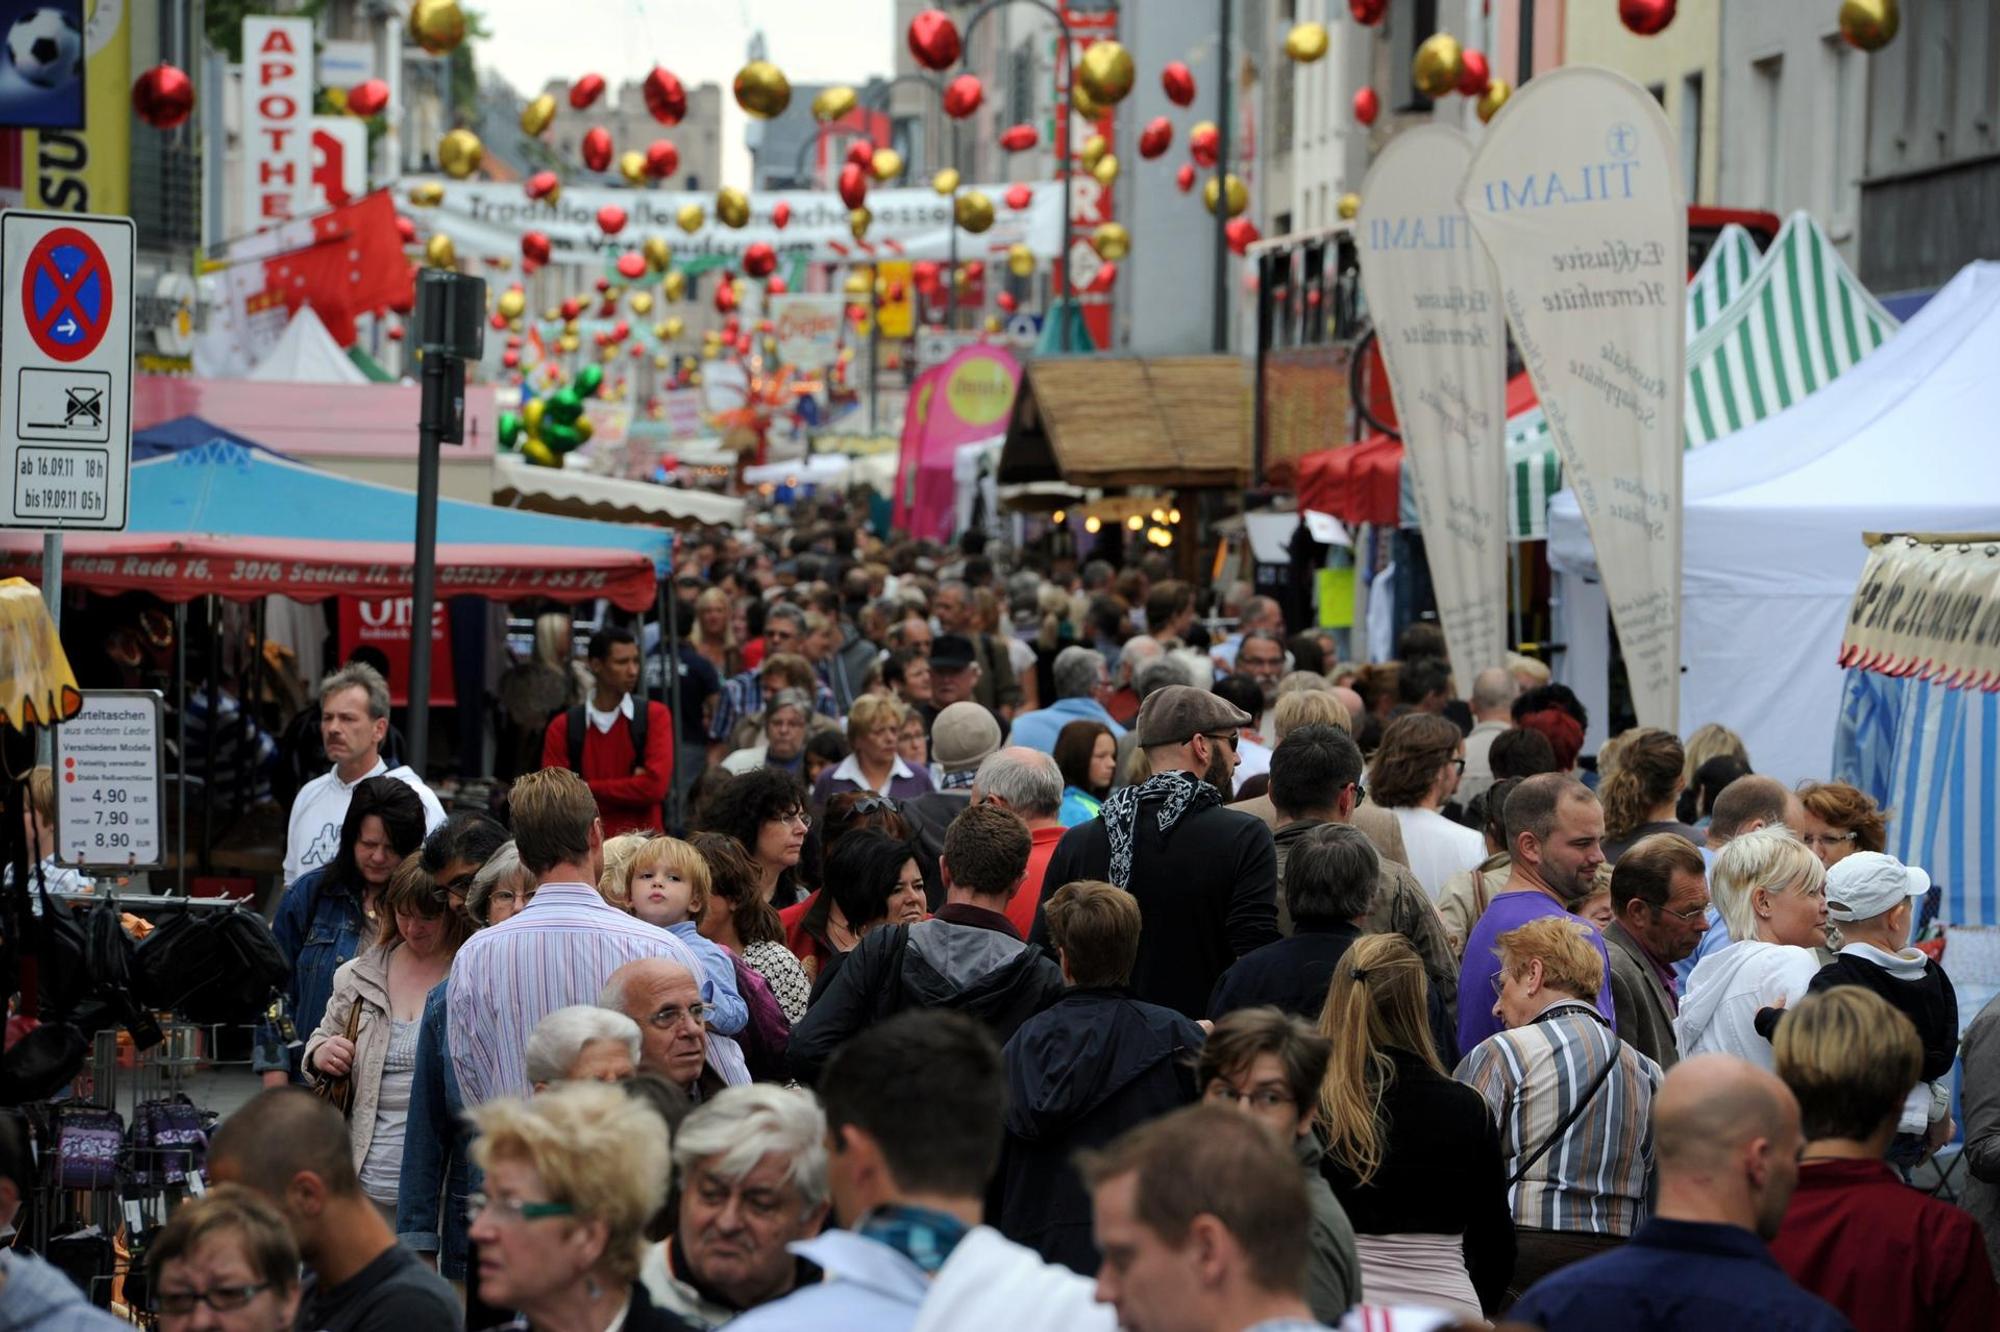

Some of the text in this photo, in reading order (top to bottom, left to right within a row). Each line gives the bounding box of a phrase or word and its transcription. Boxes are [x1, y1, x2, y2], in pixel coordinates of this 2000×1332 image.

[258, 28, 297, 234] APOTHE
[20, 456, 33, 475] ab
[37, 457, 74, 477] 16.09.11
[25, 489, 40, 508] bis
[42, 490, 77, 509] 19.09.11
[122, 553, 178, 578] Rade
[123, 726, 151, 736] Leder
[92, 789, 127, 804] 4,90
[94, 811, 129, 826] 7,90
[95, 833, 130, 848] 8,90
